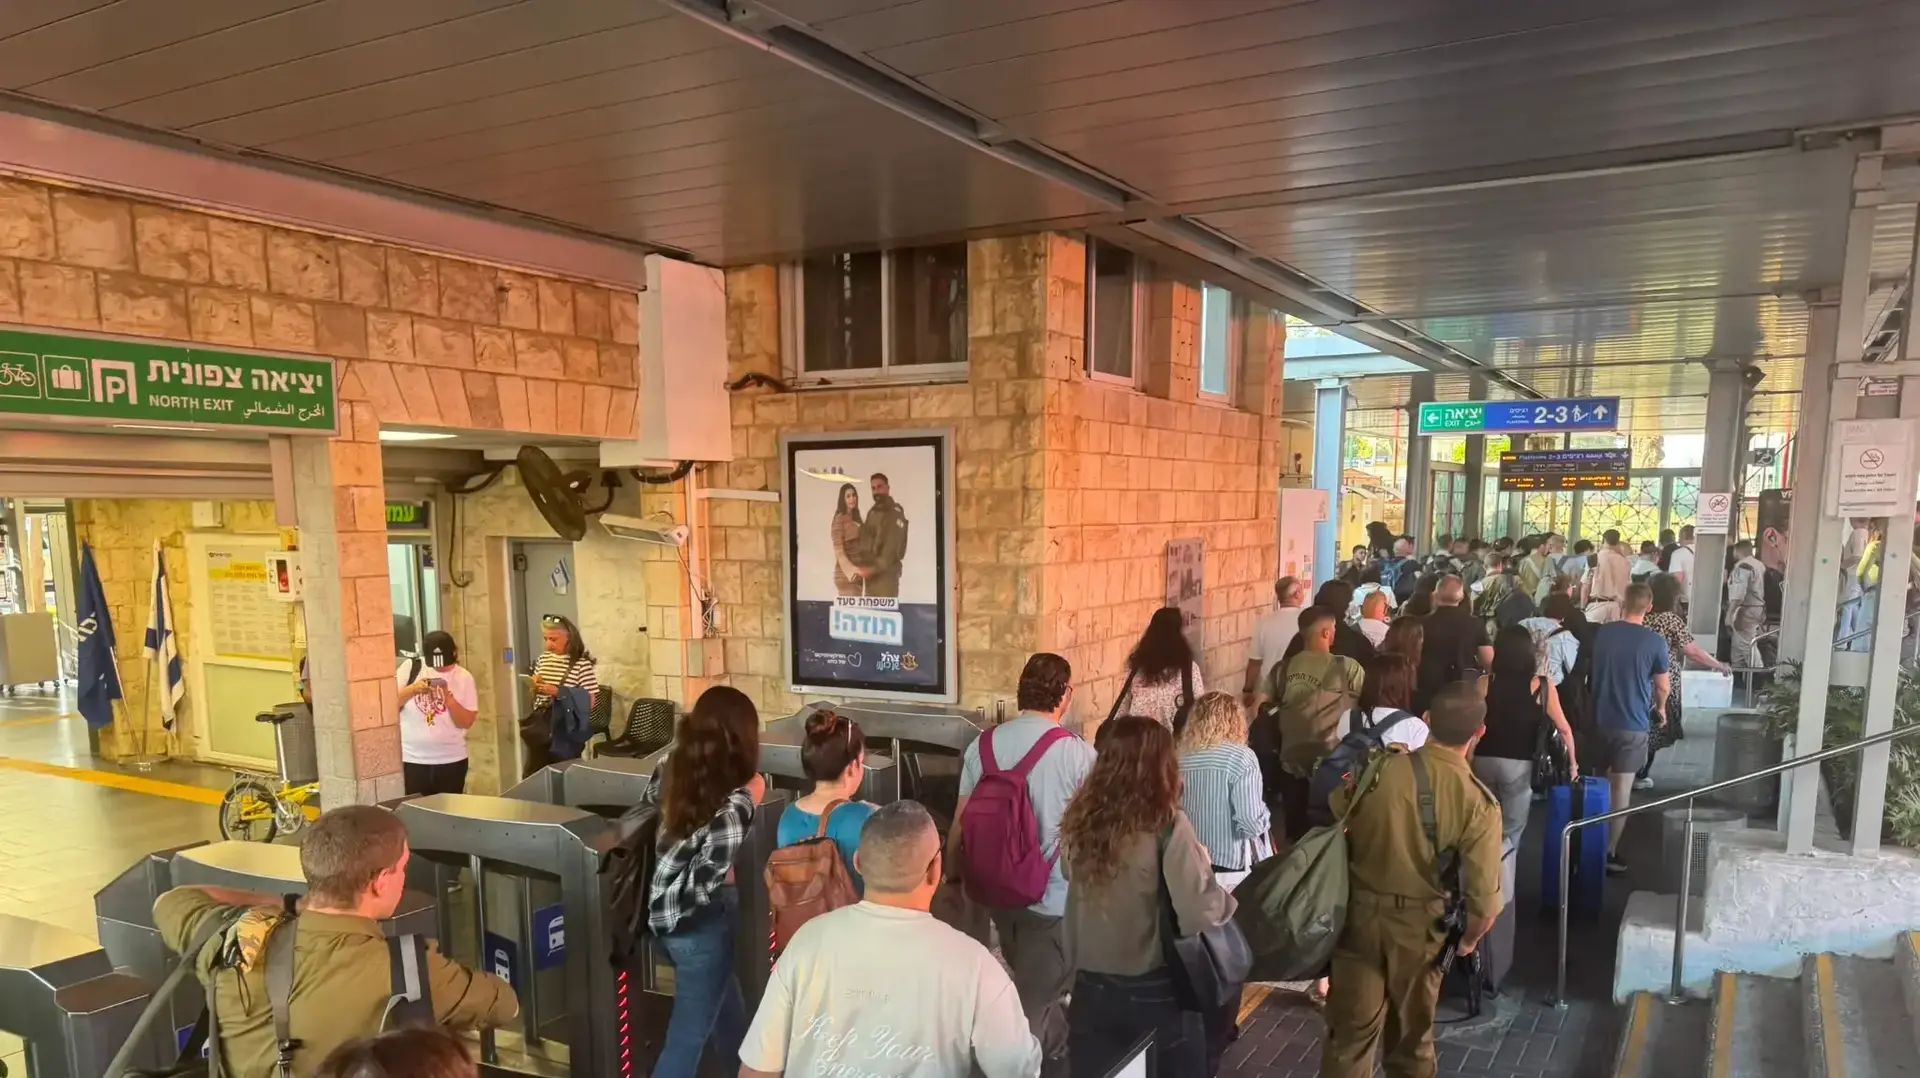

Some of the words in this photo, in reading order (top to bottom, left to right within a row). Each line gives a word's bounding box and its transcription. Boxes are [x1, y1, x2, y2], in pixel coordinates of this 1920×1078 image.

[147, 360, 244, 388] צפונית
[251, 368, 323, 394] יציאה
[149, 394, 199, 409] NORTH
[203, 398, 234, 411] EXIT
[1444, 408, 1482, 419] יציאה
[1533, 406, 1568, 424] 2-3
[836, 597, 856, 606] סעד
[858, 598, 895, 607] משפחת
[834, 610, 896, 638] תודה!
[792, 1012, 859, 1062] Keep
[864, 1024, 936, 1061] Your
